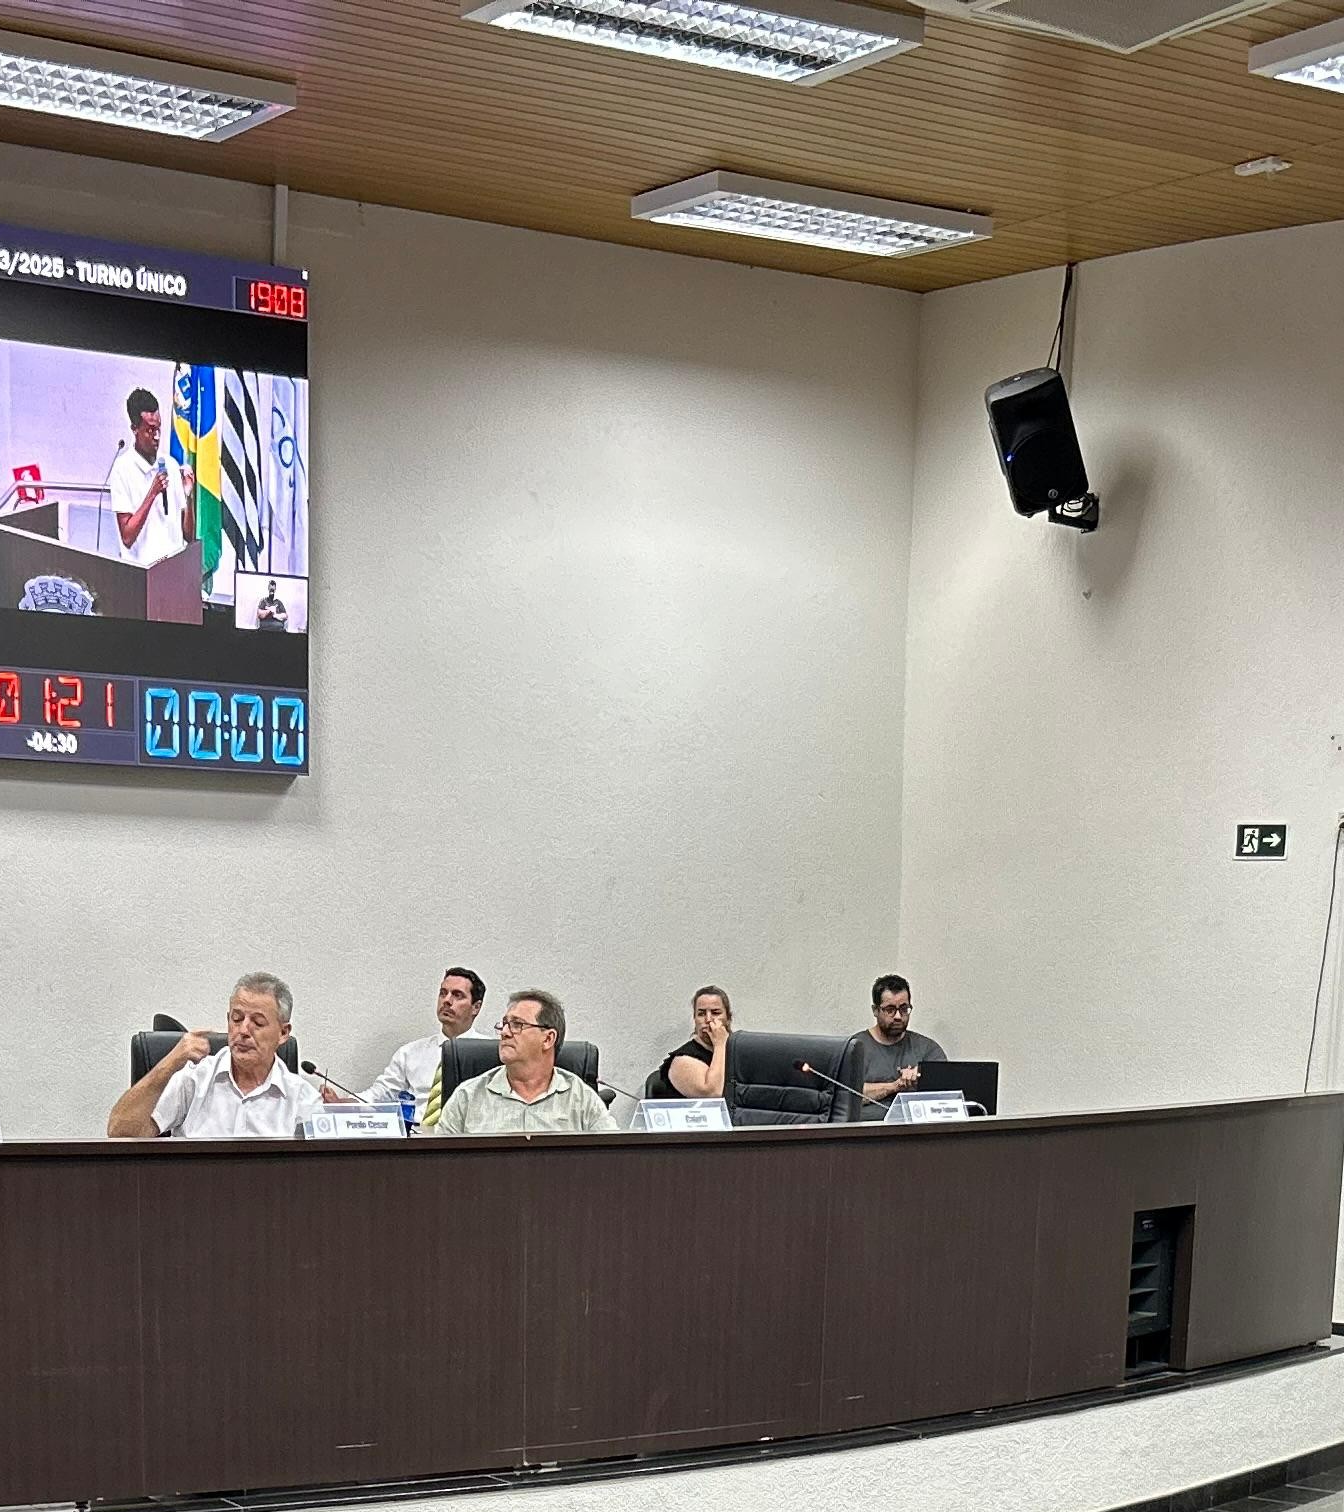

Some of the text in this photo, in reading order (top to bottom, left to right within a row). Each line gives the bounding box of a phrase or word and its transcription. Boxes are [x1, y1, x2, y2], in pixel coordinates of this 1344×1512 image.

[76, 260, 133, 289] TURNO
[137, 266, 187, 296] ÚNICO
[145, 688, 304, 764] 00:00
